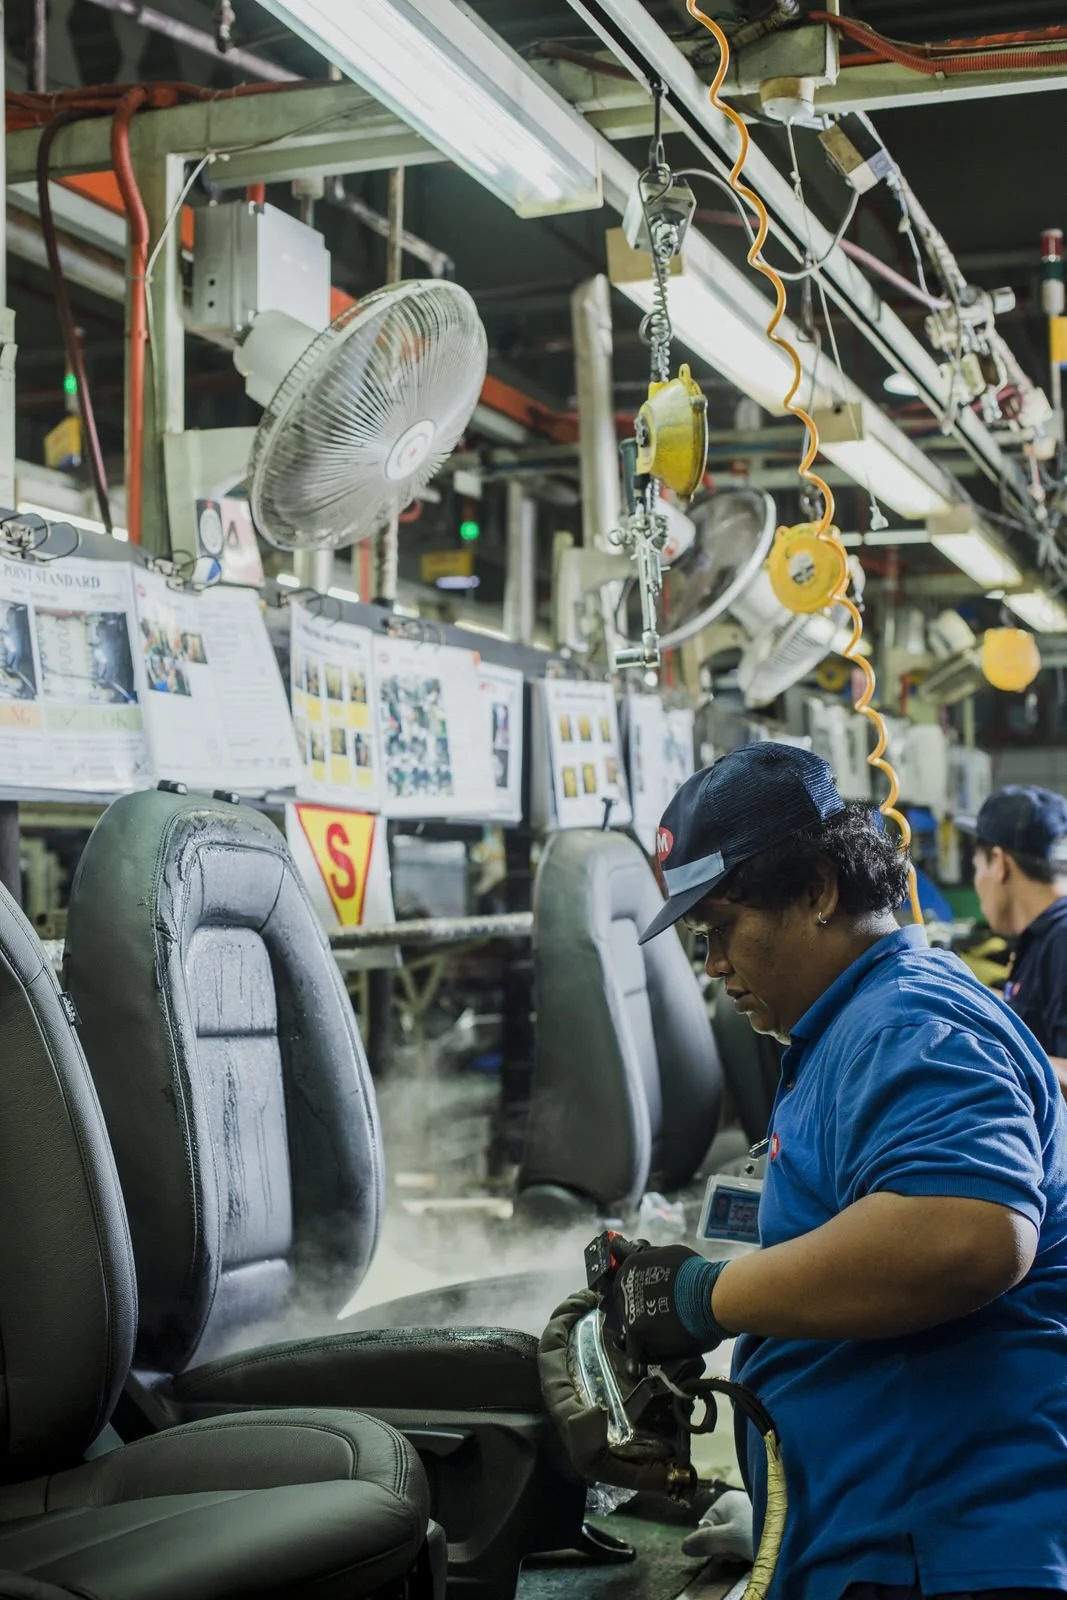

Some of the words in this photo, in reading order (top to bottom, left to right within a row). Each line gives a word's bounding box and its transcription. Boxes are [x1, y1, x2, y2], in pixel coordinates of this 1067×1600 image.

[4, 563, 32, 582] POINT
[36, 570, 101, 589] STANDARD
[102, 710, 129, 728] OK
[326, 822, 357, 900] S
